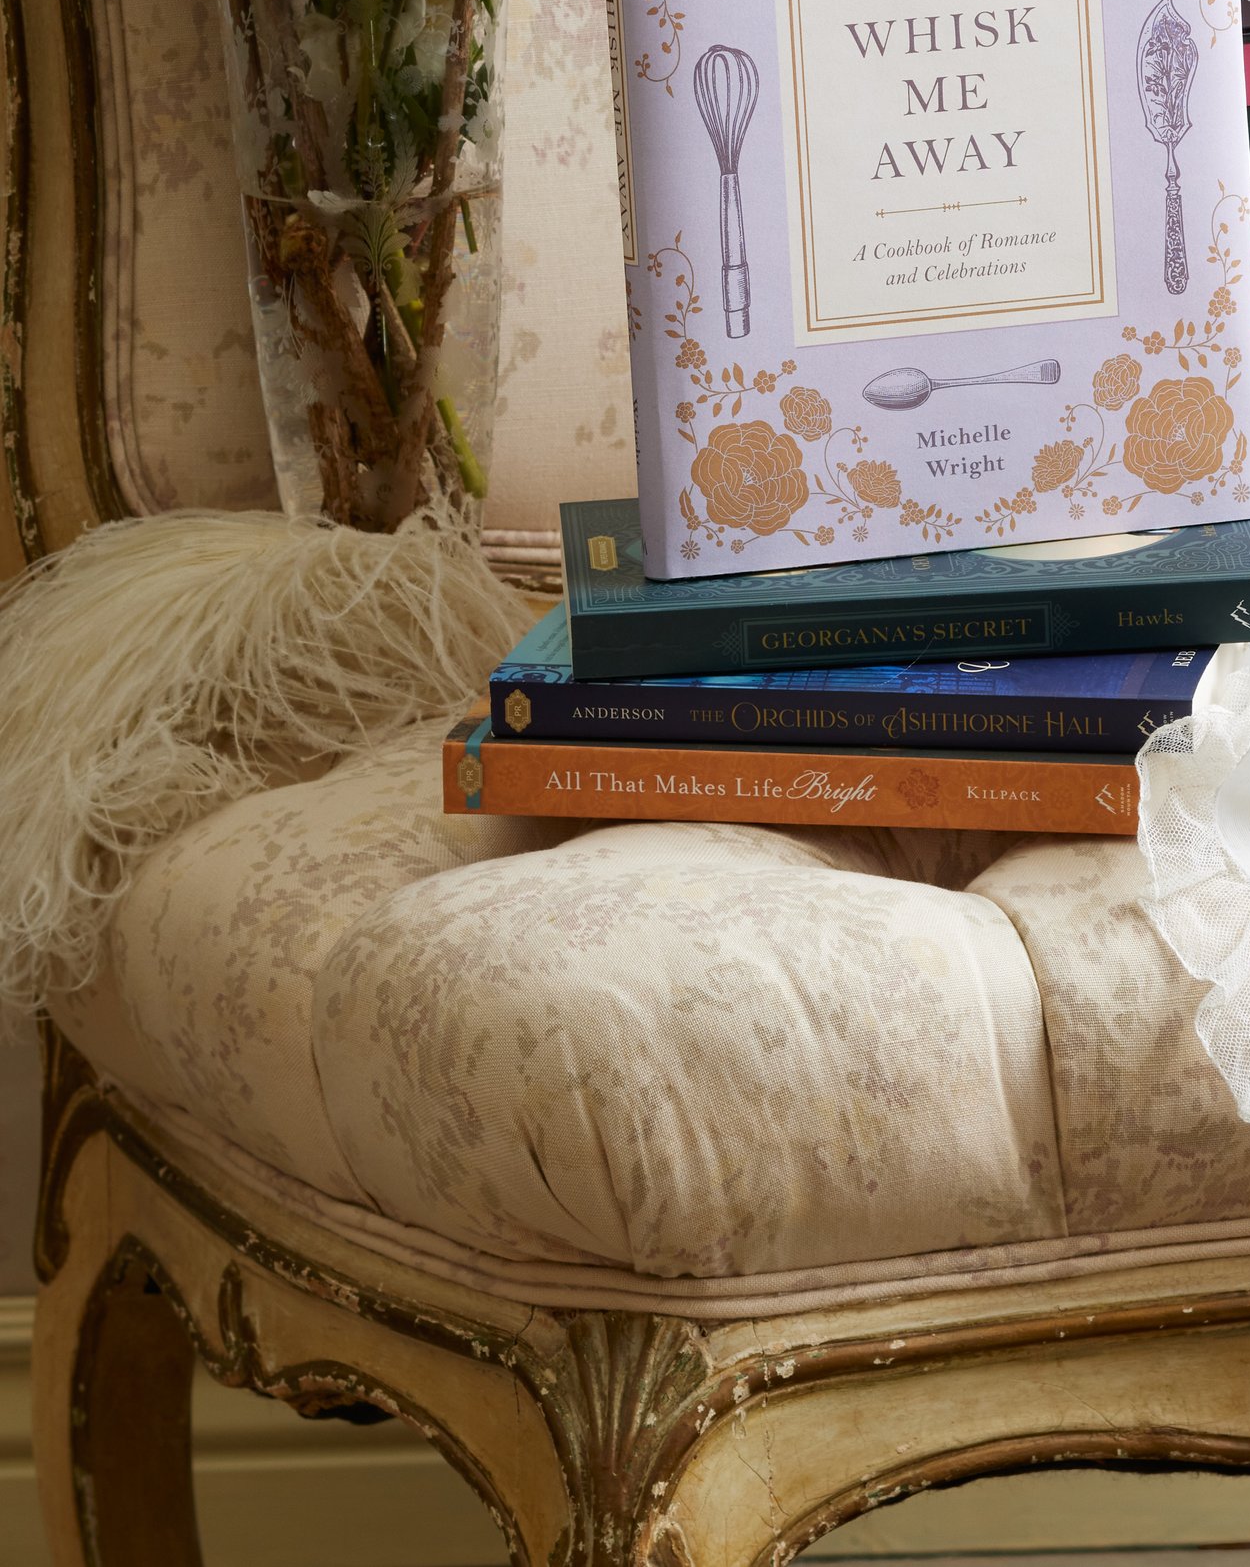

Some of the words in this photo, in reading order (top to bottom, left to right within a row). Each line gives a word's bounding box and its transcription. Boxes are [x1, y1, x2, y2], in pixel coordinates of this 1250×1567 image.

[844, 7, 1038, 58] WHISK
[902, 74, 987, 116] ME
[871, 131, 1025, 180] AWAY
[853, 245, 866, 261] A
[874, 236, 951, 259] Cookbook
[959, 234, 974, 256] of
[981, 232, 1056, 249] Romance
[886, 267, 918, 285] and
[925, 262, 1026, 281] Celebrations
[916, 425, 1010, 448] Michelle
[926, 455, 1005, 479] Wright
[1119, 609, 1183, 626] Hawks
[762, 625, 927, 653] GEORGANA'S
[932, 619, 1031, 639] SECRET
[573, 707, 664, 720] ANDERSON
[545, 771, 581, 790] All
[590, 773, 645, 792] That
[655, 775, 725, 795] Makes
[736, 778, 782, 797] Life
[786, 770, 878, 813] Bright
